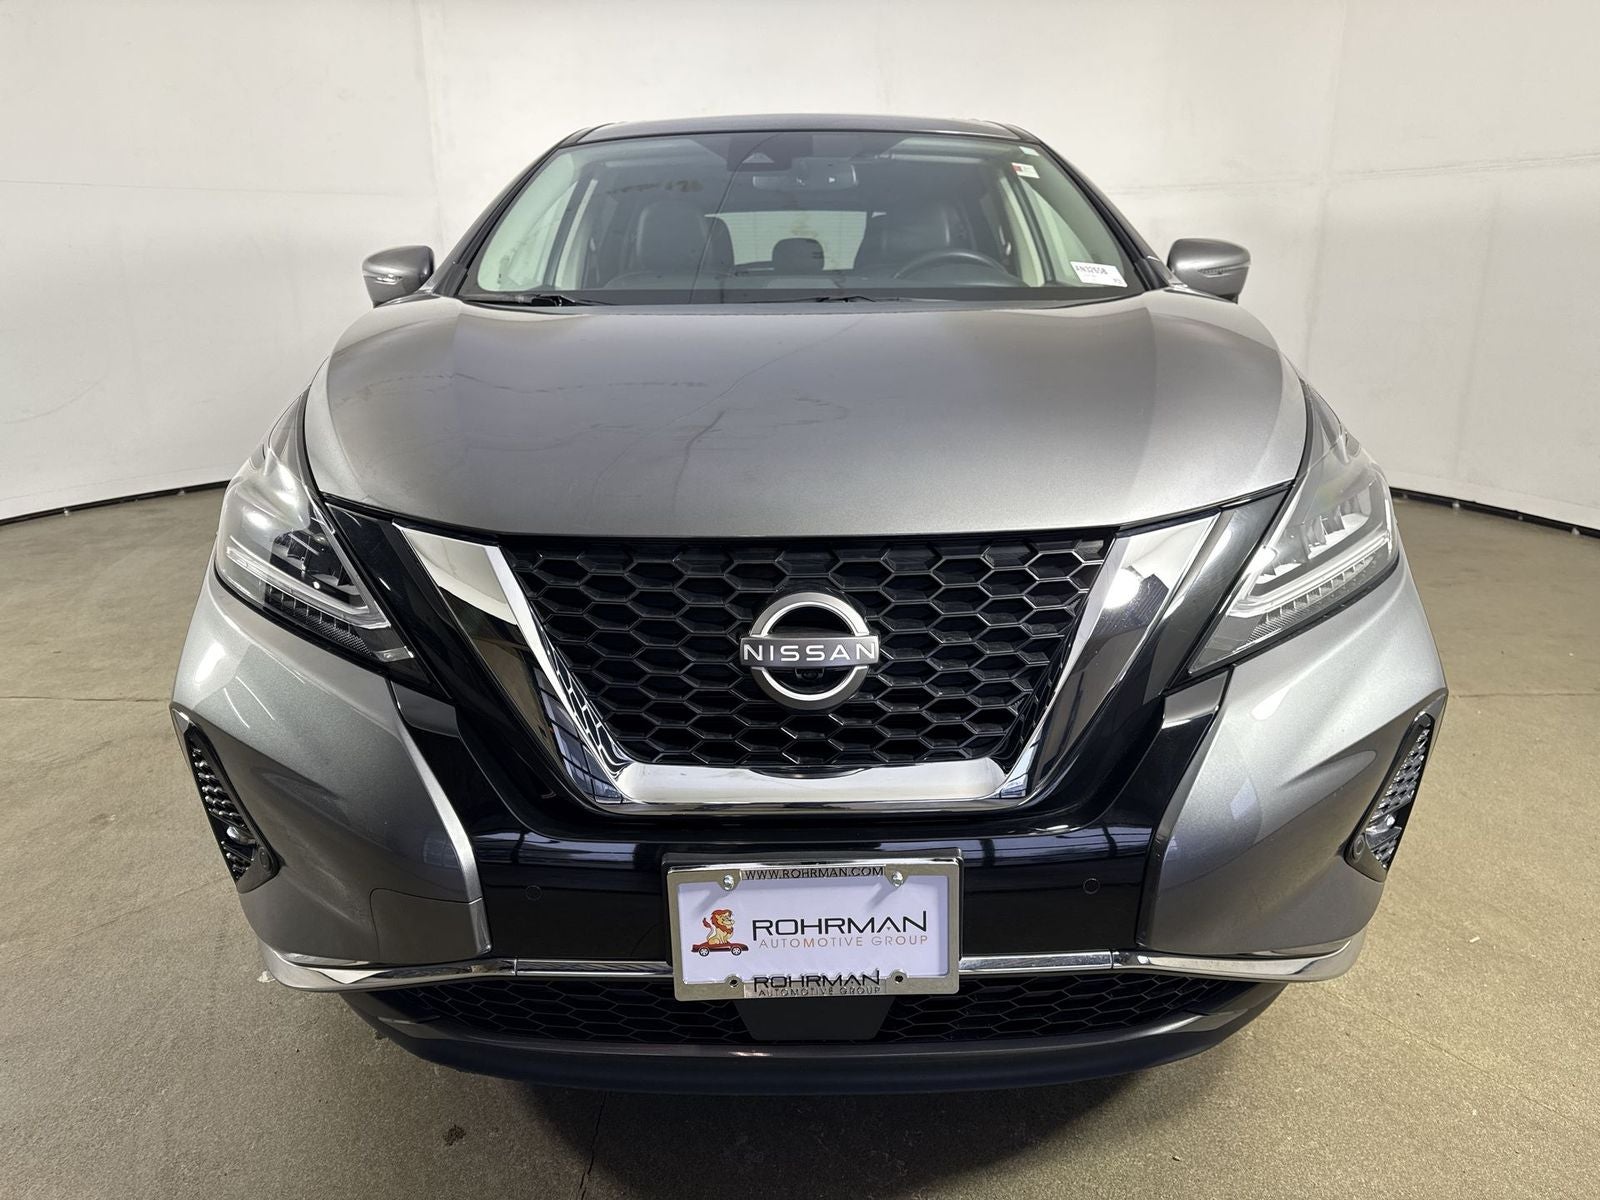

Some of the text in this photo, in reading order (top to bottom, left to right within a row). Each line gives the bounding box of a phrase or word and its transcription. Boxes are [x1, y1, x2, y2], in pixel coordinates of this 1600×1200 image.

[743, 643, 876, 662] NISSAN
[745, 866, 884, 880] WWW.ROHRMAN.COM
[752, 910, 927, 941] ROHRMAN
[759, 935, 928, 949] AUTOMOTIVE GROUP
[753, 969, 880, 992] ROHRMAN
[758, 985, 881, 997] AUTOMOTIVE GROUP
